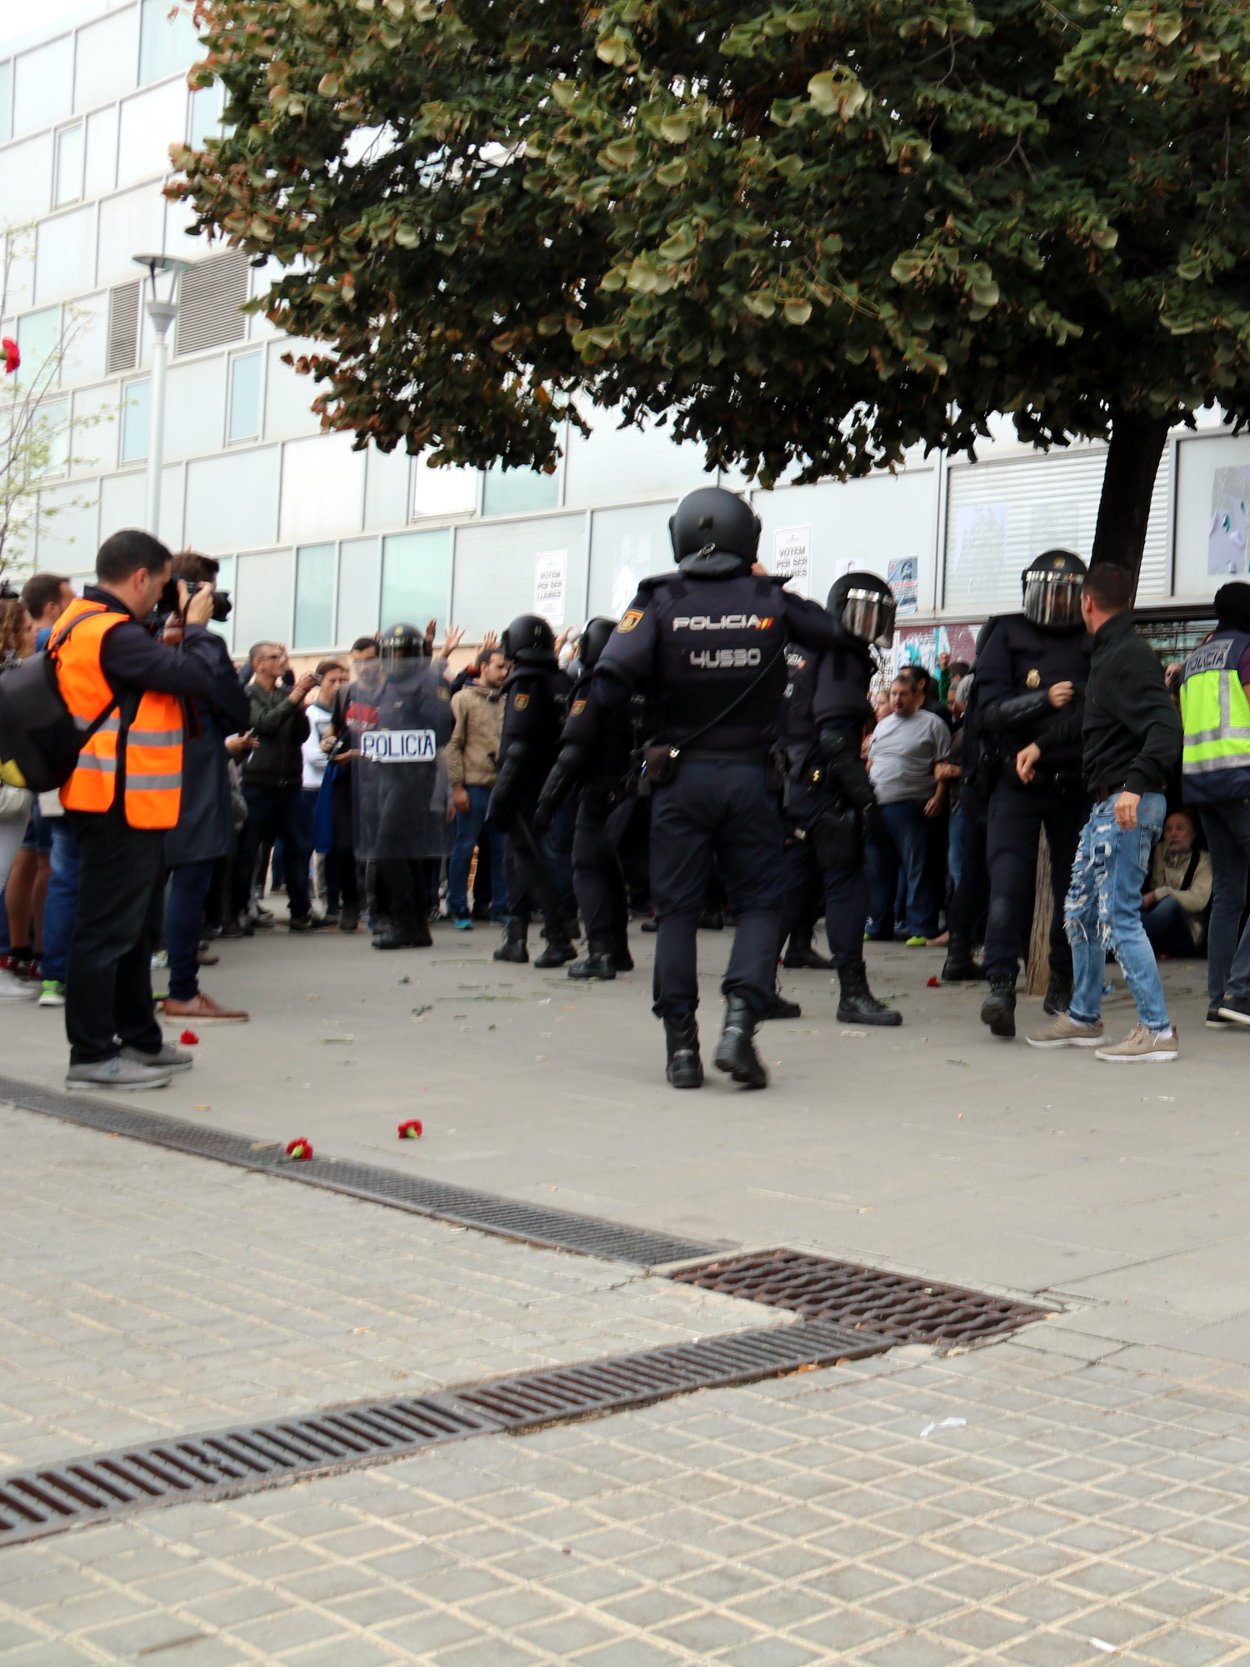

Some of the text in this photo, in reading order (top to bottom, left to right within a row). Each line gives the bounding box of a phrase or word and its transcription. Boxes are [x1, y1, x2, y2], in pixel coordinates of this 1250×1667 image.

[779, 545, 805, 557] VOTEM
[777, 556, 807, 568] PER SER
[672, 614, 762, 631] POLICIA
[364, 734, 434, 757] POLICIA
